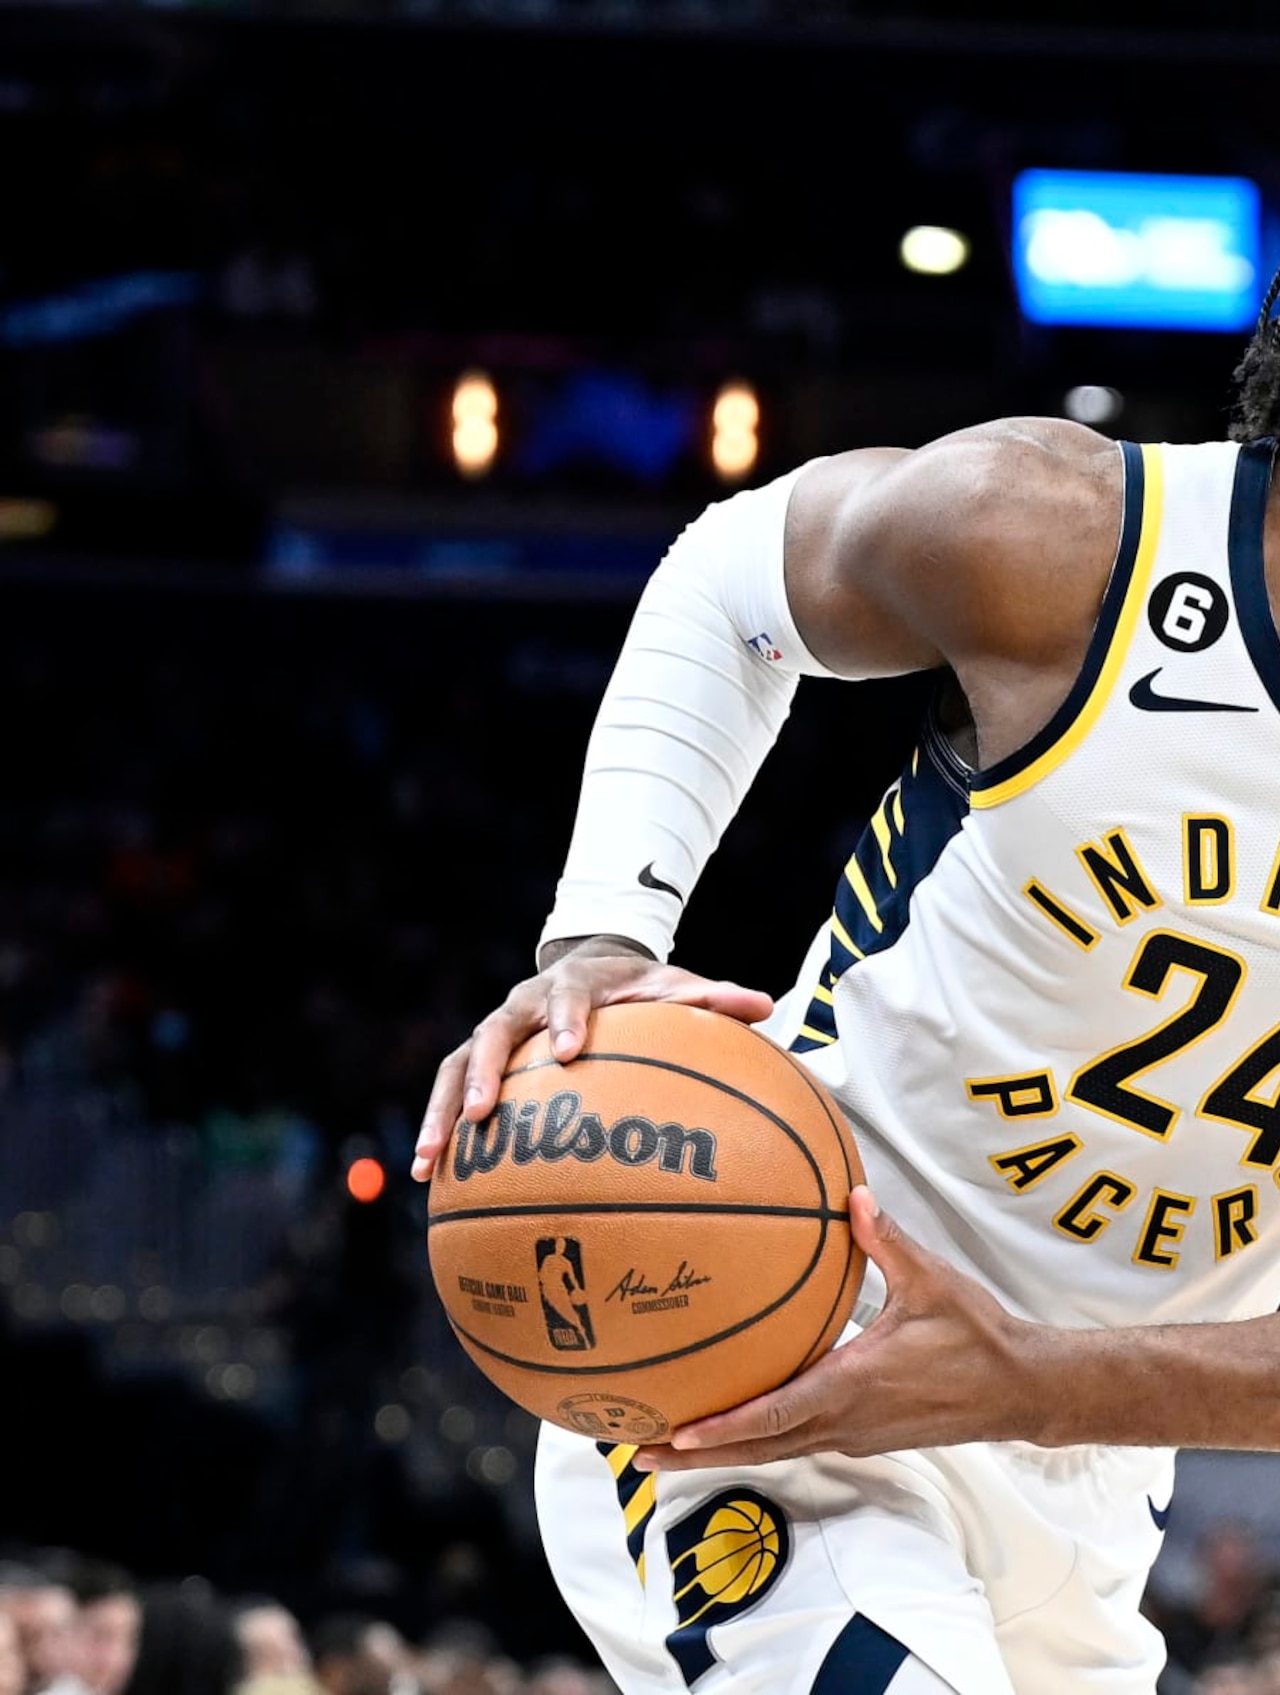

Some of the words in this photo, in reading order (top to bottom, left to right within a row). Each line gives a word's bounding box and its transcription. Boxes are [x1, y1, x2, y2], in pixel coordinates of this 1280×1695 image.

[1162, 582, 1214, 644] 6
[453, 1090, 717, 1181] Wilson
[507, 1285, 528, 1303] BALL
